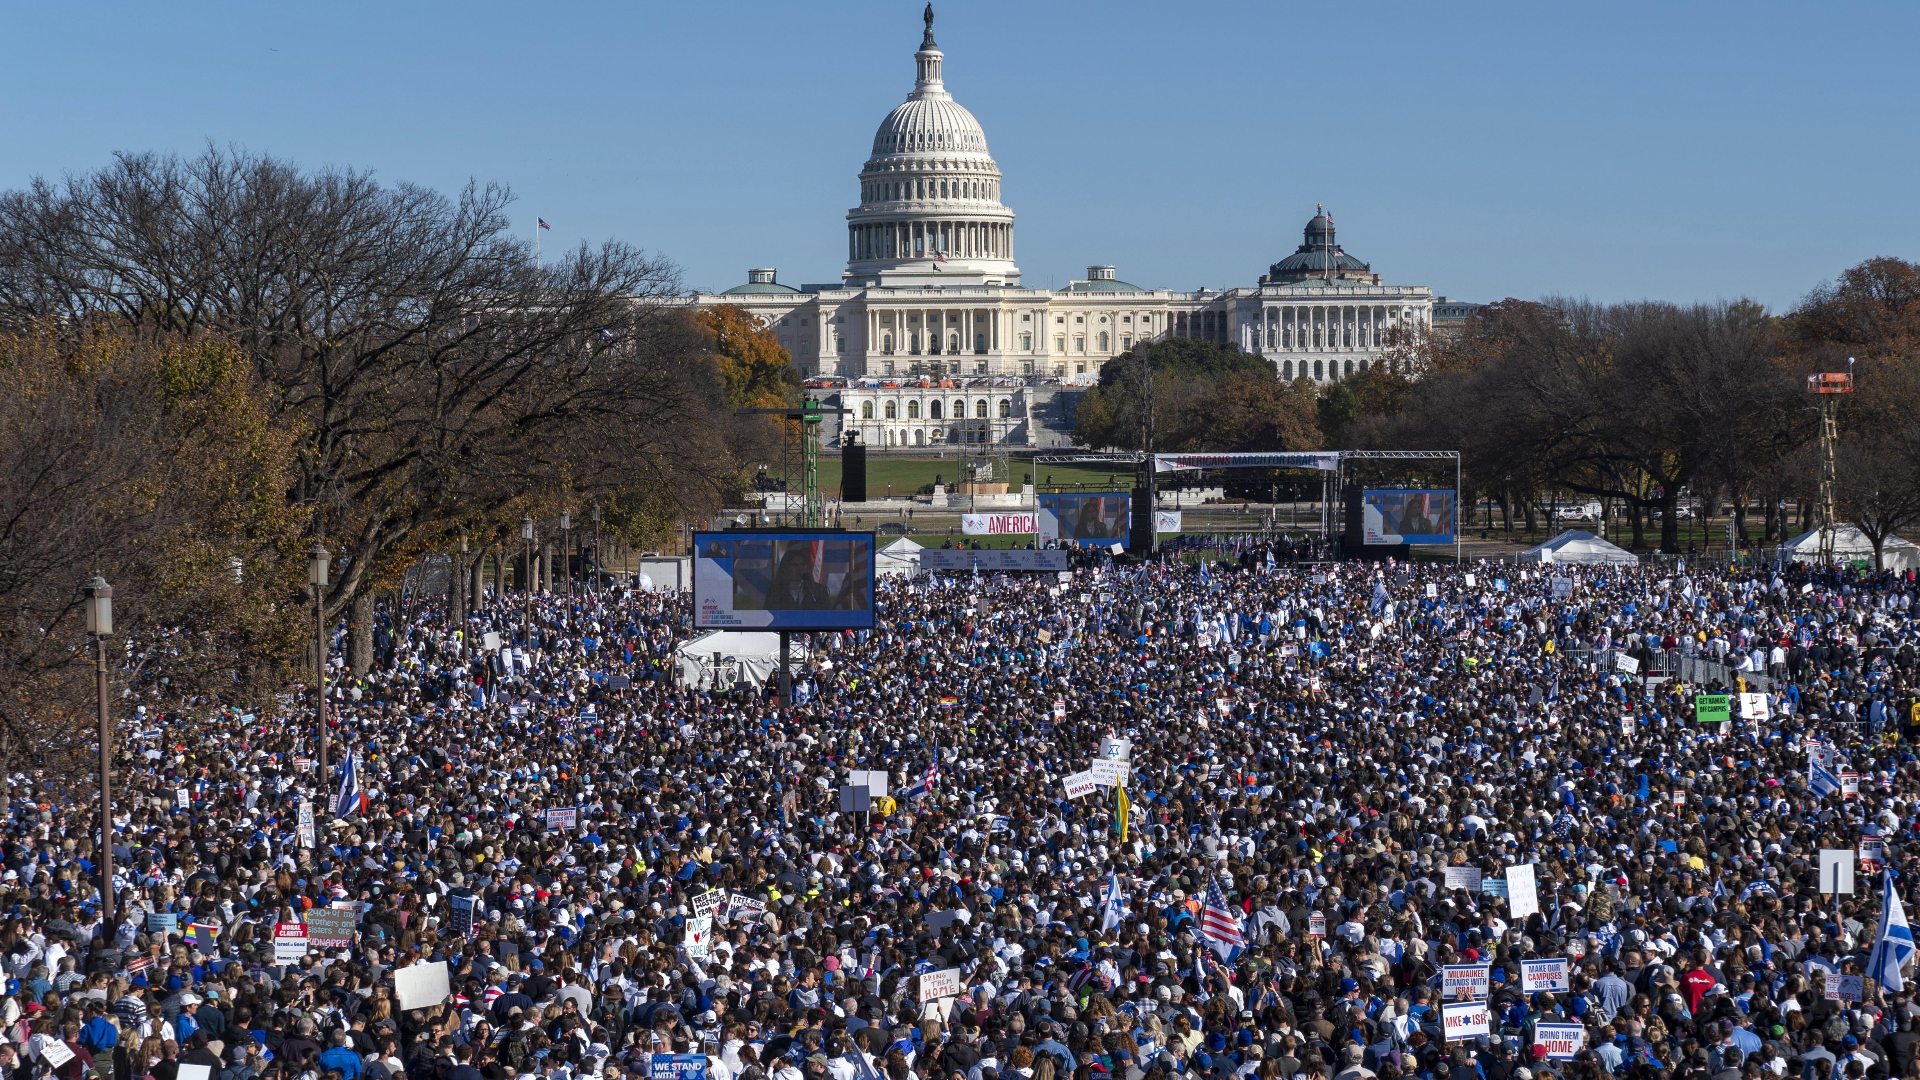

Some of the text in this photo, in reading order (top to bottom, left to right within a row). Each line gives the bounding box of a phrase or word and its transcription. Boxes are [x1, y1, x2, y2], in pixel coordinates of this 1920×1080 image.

[1176, 455, 1319, 468] AMERICANS MARCH FOR ISRAEL
[988, 515, 1040, 534] AMERICA
[1699, 697, 1708, 705] GET
[1708, 705, 1727, 713] CAMPUS
[1069, 782, 1094, 796] HAMAS
[882, 801, 888, 811] 7
[693, 890, 721, 905] FREE THE
[695, 894, 726, 909] HOSTAGES
[733, 896, 748, 905] FREE
[307, 908, 332, 917] 240+
[343, 910, 355, 918] my
[307, 917, 355, 928] brothers and
[337, 928, 351, 936] are
[308, 937, 353, 948] KIDNAPPED
[1528, 963, 1561, 973] MAKE OUR
[922, 972, 947, 983] BRING
[1447, 969, 1485, 979] MILWAUKEE
[1527, 971, 1563, 982] CAMPUSES
[930, 977, 953, 988] THEM
[1444, 977, 1487, 987] STANDS WITH
[1534, 980, 1550, 989] SAFE
[1826, 976, 1840, 984] FREE
[924, 984, 956, 1000] HOME
[1455, 986, 1477, 995] ISRAEL
[1826, 983, 1837, 991] THE
[1825, 991, 1856, 1000] HOSTAGES
[1445, 1014, 1487, 1028] MKE ISR
[1539, 1030, 1579, 1040] BRING THEM
[1545, 1040, 1573, 1053] HOME
[654, 1062, 702, 1071] WE STAND
